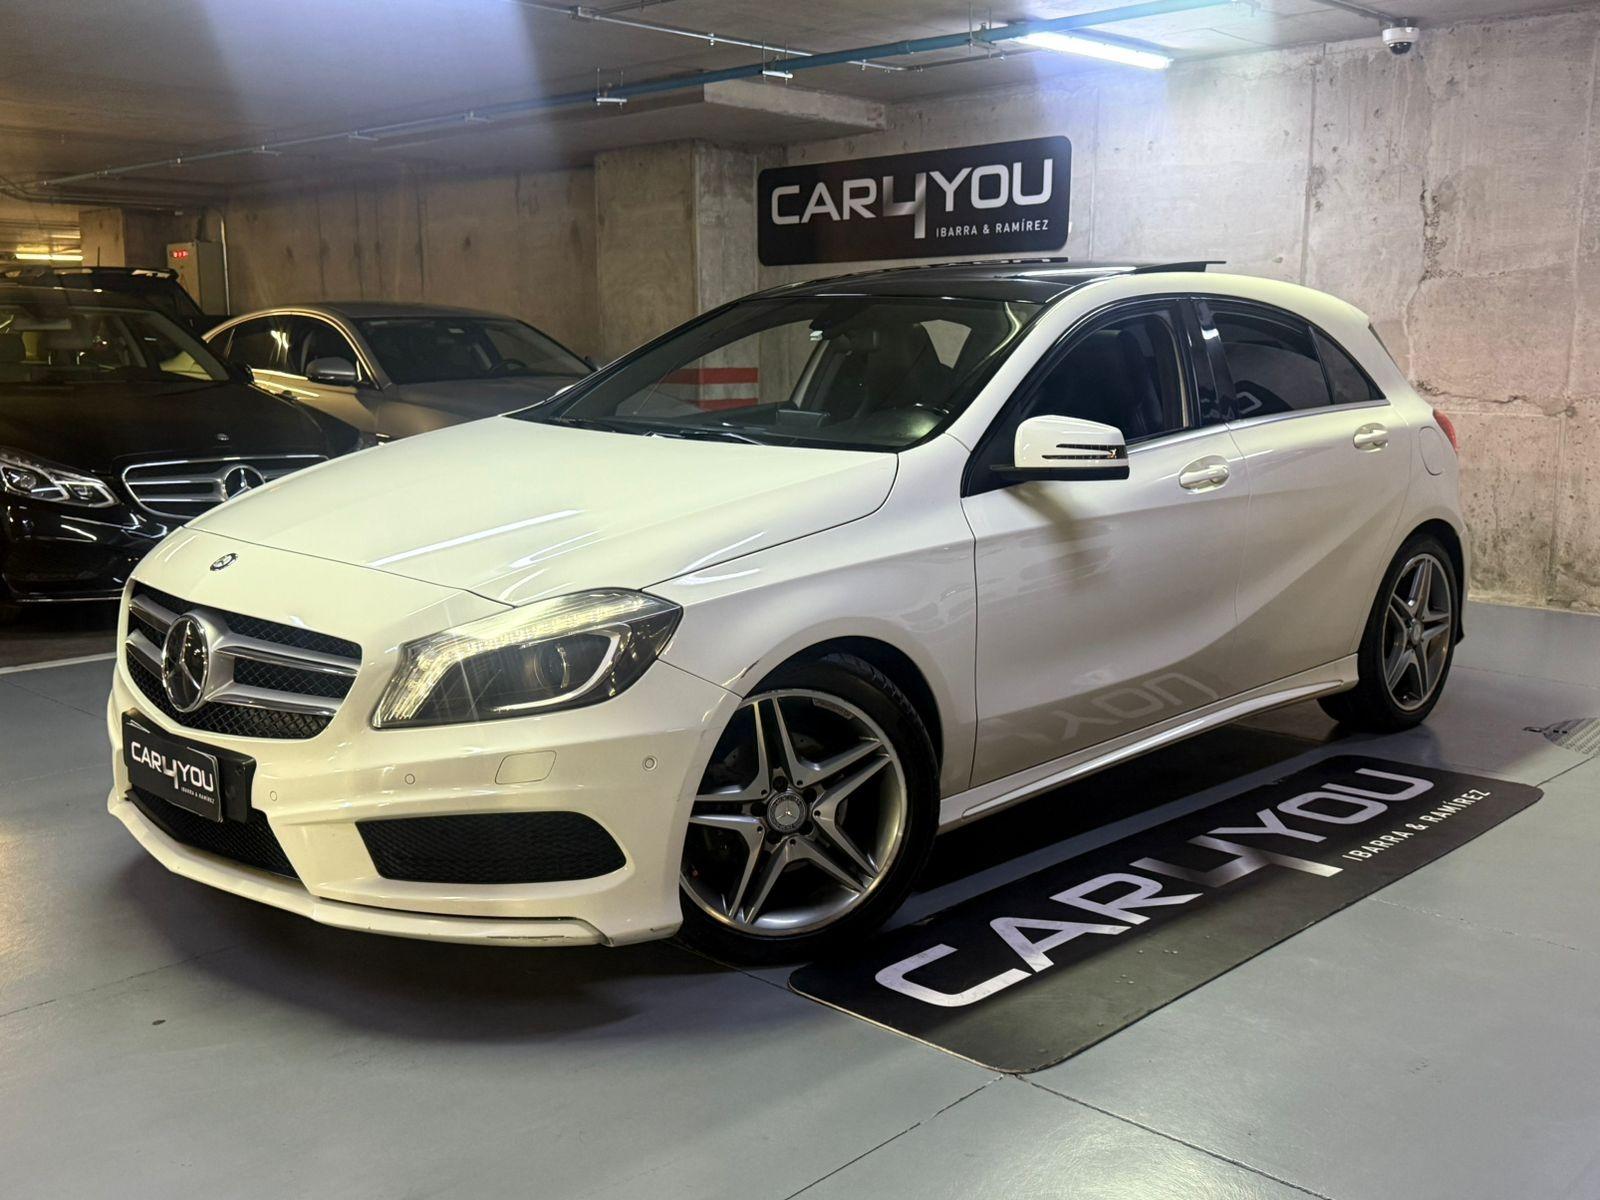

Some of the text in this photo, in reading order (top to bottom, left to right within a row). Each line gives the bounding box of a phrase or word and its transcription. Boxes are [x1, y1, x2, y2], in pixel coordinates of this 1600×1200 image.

[771, 158, 1053, 239] CAR4YOU
[936, 218, 1049, 238] IBARRA & RAMÍREZ
[131, 741, 214, 792] CAR4YOU
[1342, 789, 1491, 861] IBARRA & RAMÍREZ
[875, 768, 1435, 1007] CAR4YOU
